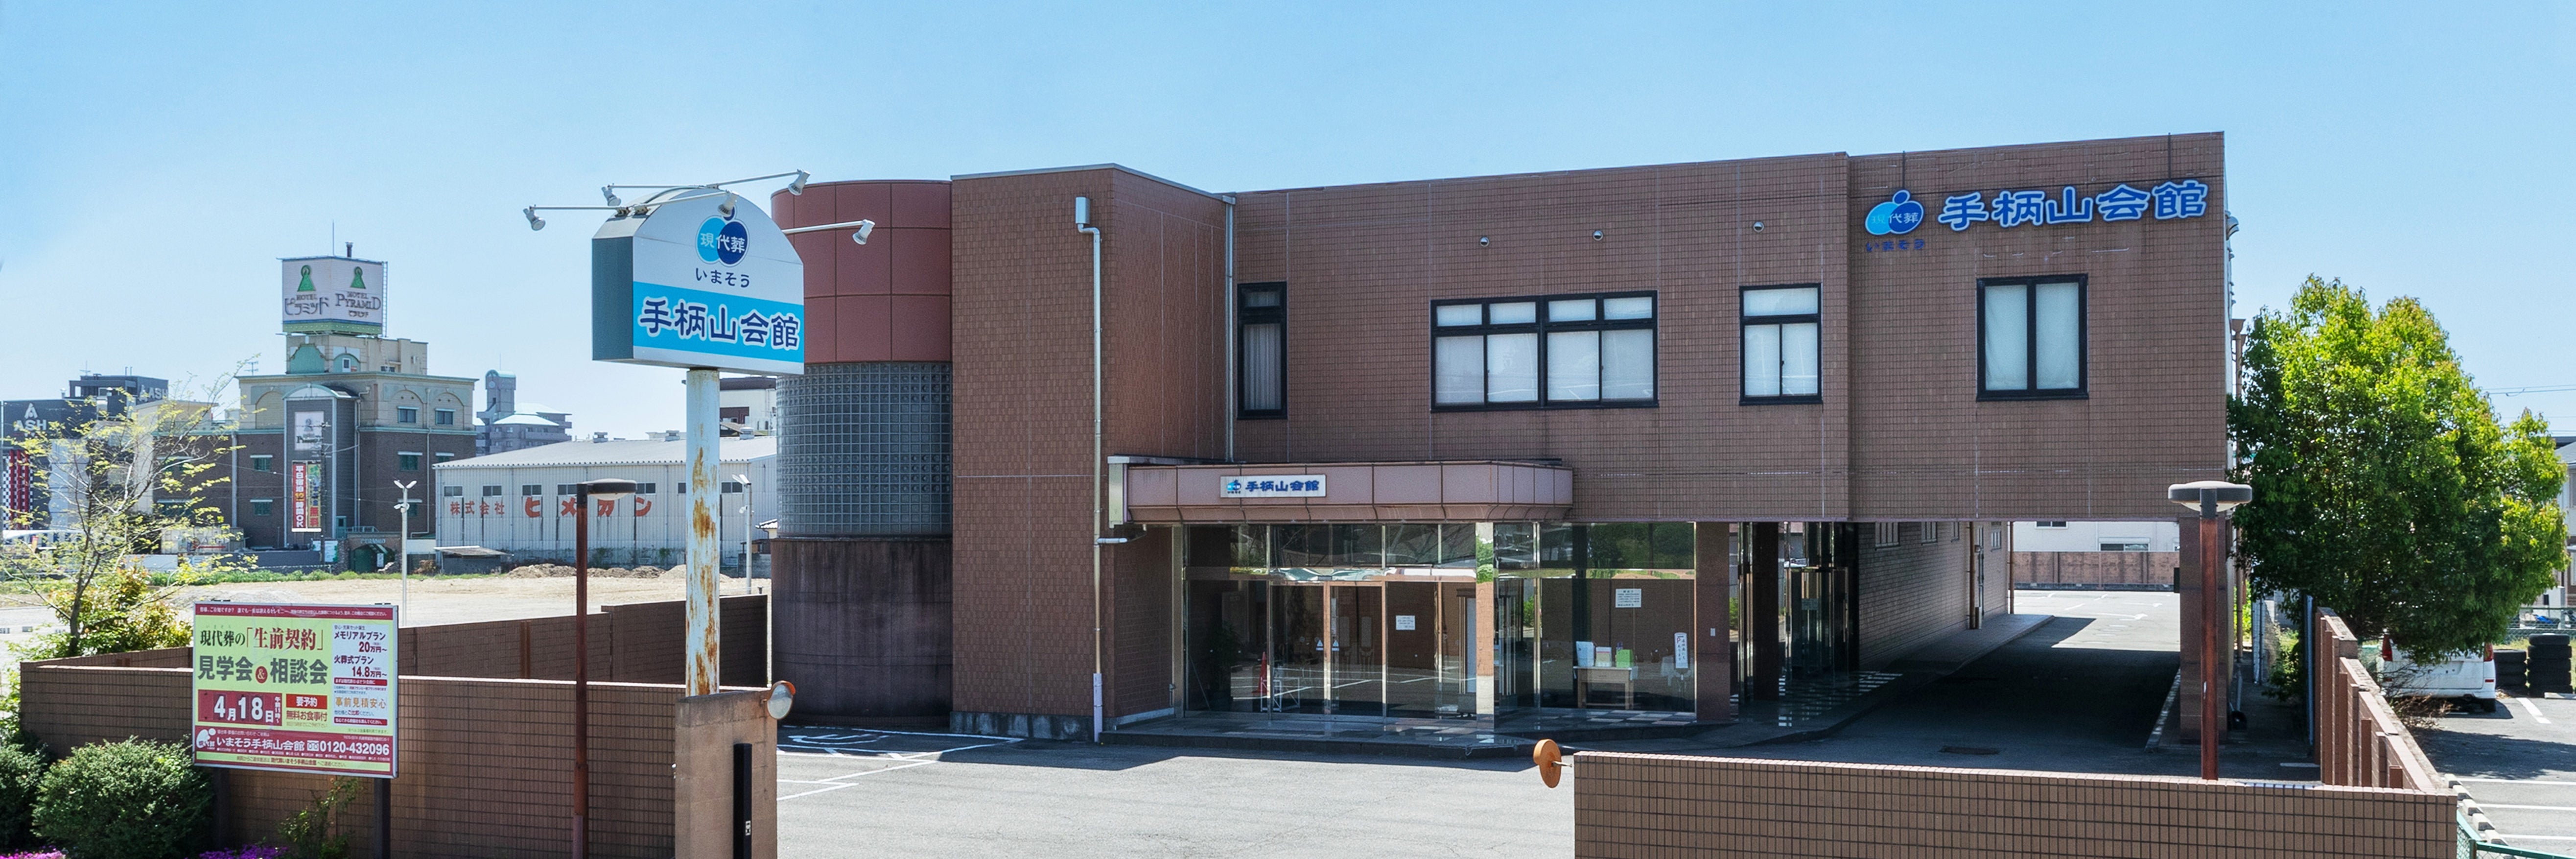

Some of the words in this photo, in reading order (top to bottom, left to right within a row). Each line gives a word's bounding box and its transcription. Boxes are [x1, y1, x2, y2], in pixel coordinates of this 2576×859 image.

[1938, 179, 2208, 231] 手柄山会館
[1871, 212, 1919, 224] 現代葬
[700, 232, 746, 254] 現代葬
[1866, 239, 1924, 252] いまそう
[696, 267, 750, 288] いまそう
[335, 293, 381, 310] PYRAMID
[639, 298, 800, 348] 手柄山会館
[14, 419, 47, 431] ASH
[450, 501, 505, 516] 株式会社
[296, 696, 318, 707] 要予約
[335, 696, 387, 709] 事前見積安心
[286, 710, 328, 722] 無料お食事付
[216, 737, 305, 751] いまそう手柄山会館
[320, 740, 390, 756] 0120-432096
